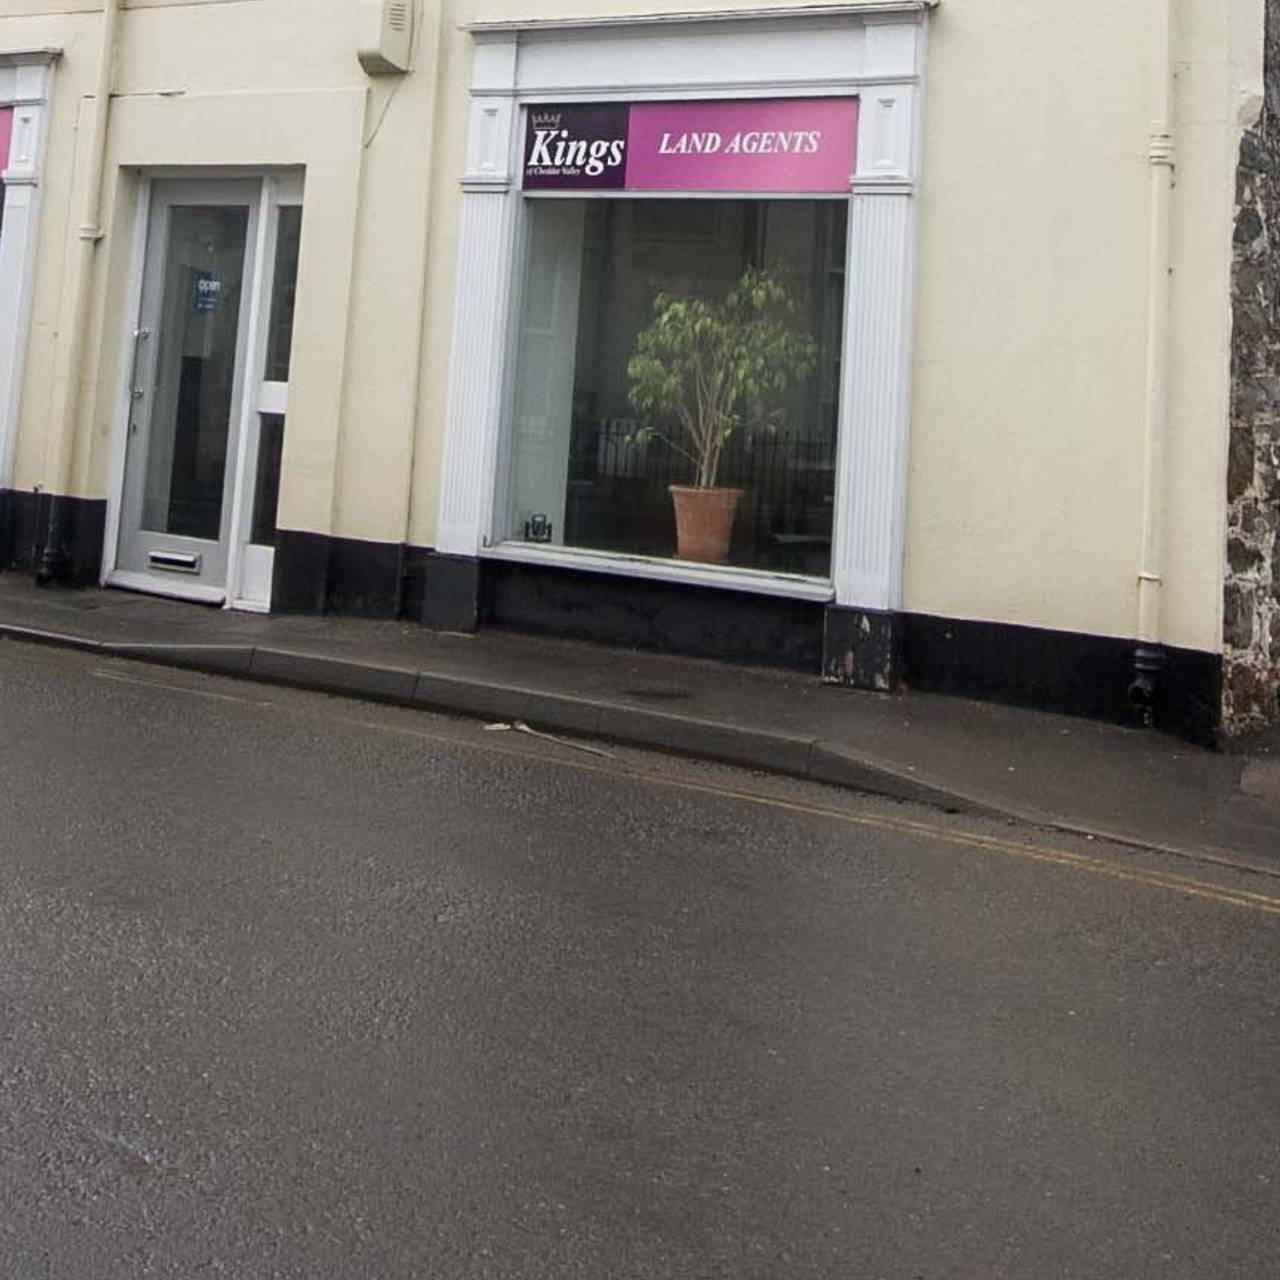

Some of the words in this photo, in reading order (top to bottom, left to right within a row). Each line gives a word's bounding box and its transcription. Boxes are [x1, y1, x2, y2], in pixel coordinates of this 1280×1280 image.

[527, 128, 625, 176] Kings
[658, 131, 721, 154] LAND
[724, 130, 821, 154] AGENTS
[198, 278, 221, 294] open
